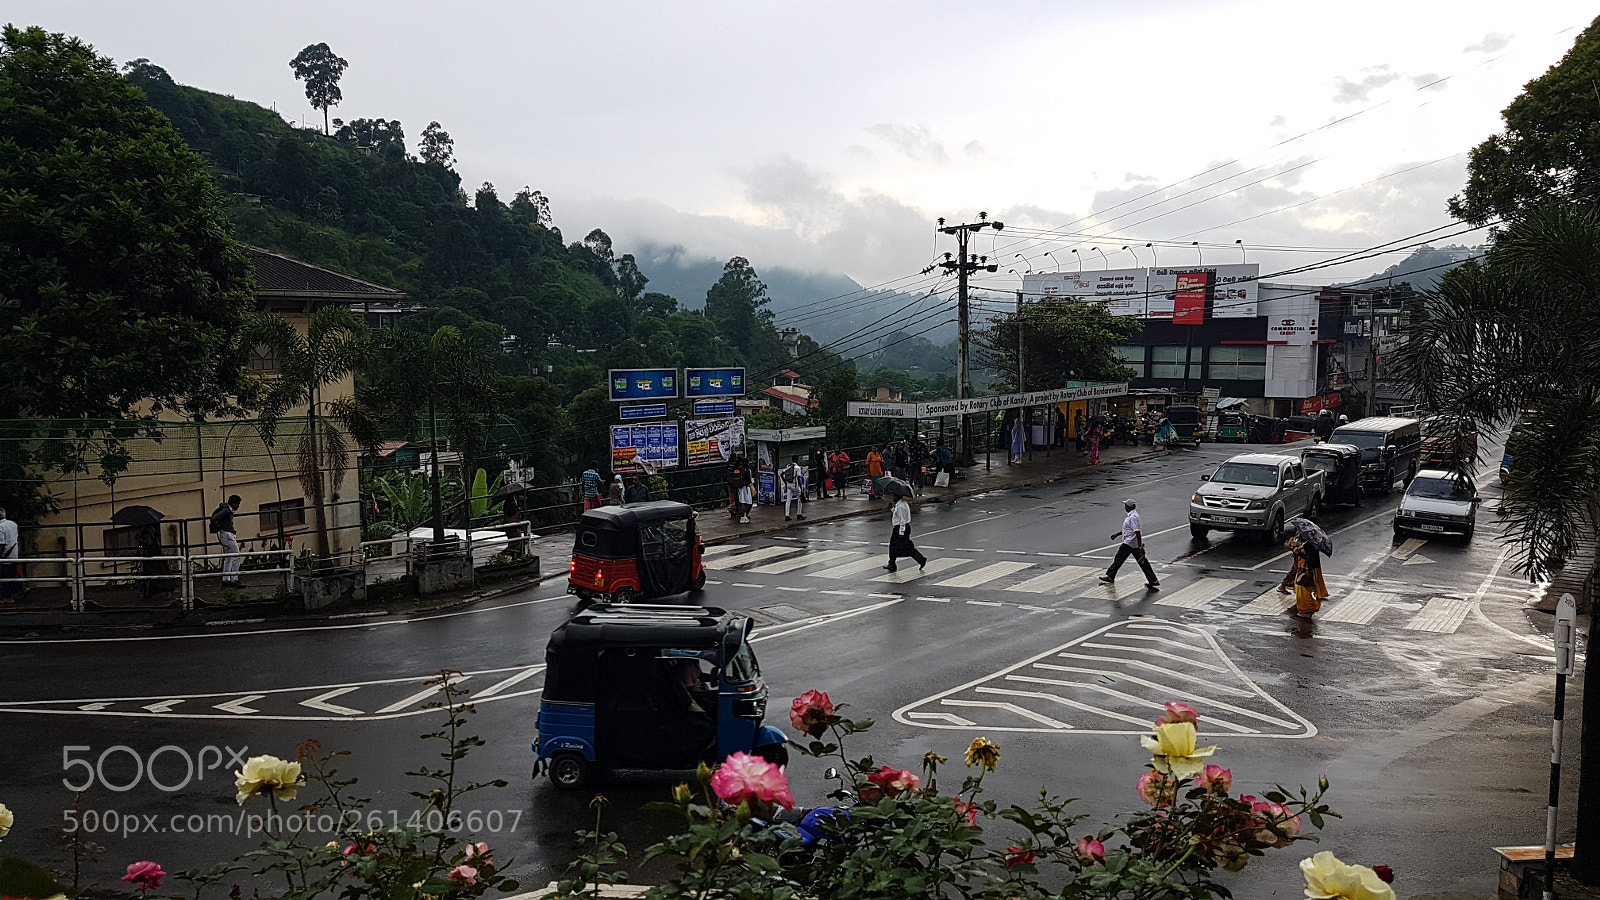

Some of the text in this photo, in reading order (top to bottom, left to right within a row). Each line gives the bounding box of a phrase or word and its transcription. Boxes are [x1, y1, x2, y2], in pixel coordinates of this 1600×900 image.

[925, 401, 959, 416] Sponsored
[960, 400, 969, 412] by
[969, 398, 988, 410] Rotary
[989, 396, 1002, 407] Club
[1003, 396, 1010, 405] of
[1009, 395, 1027, 406] Kandy
[1029, 394, 1034, 403] A
[1034, 392, 1052, 404] project
[1052, 391, 1060, 401] by
[1060, 390, 1076, 400] Rotary
[1076, 388, 1088, 398] Club
[1087, 387, 1094, 396] of
